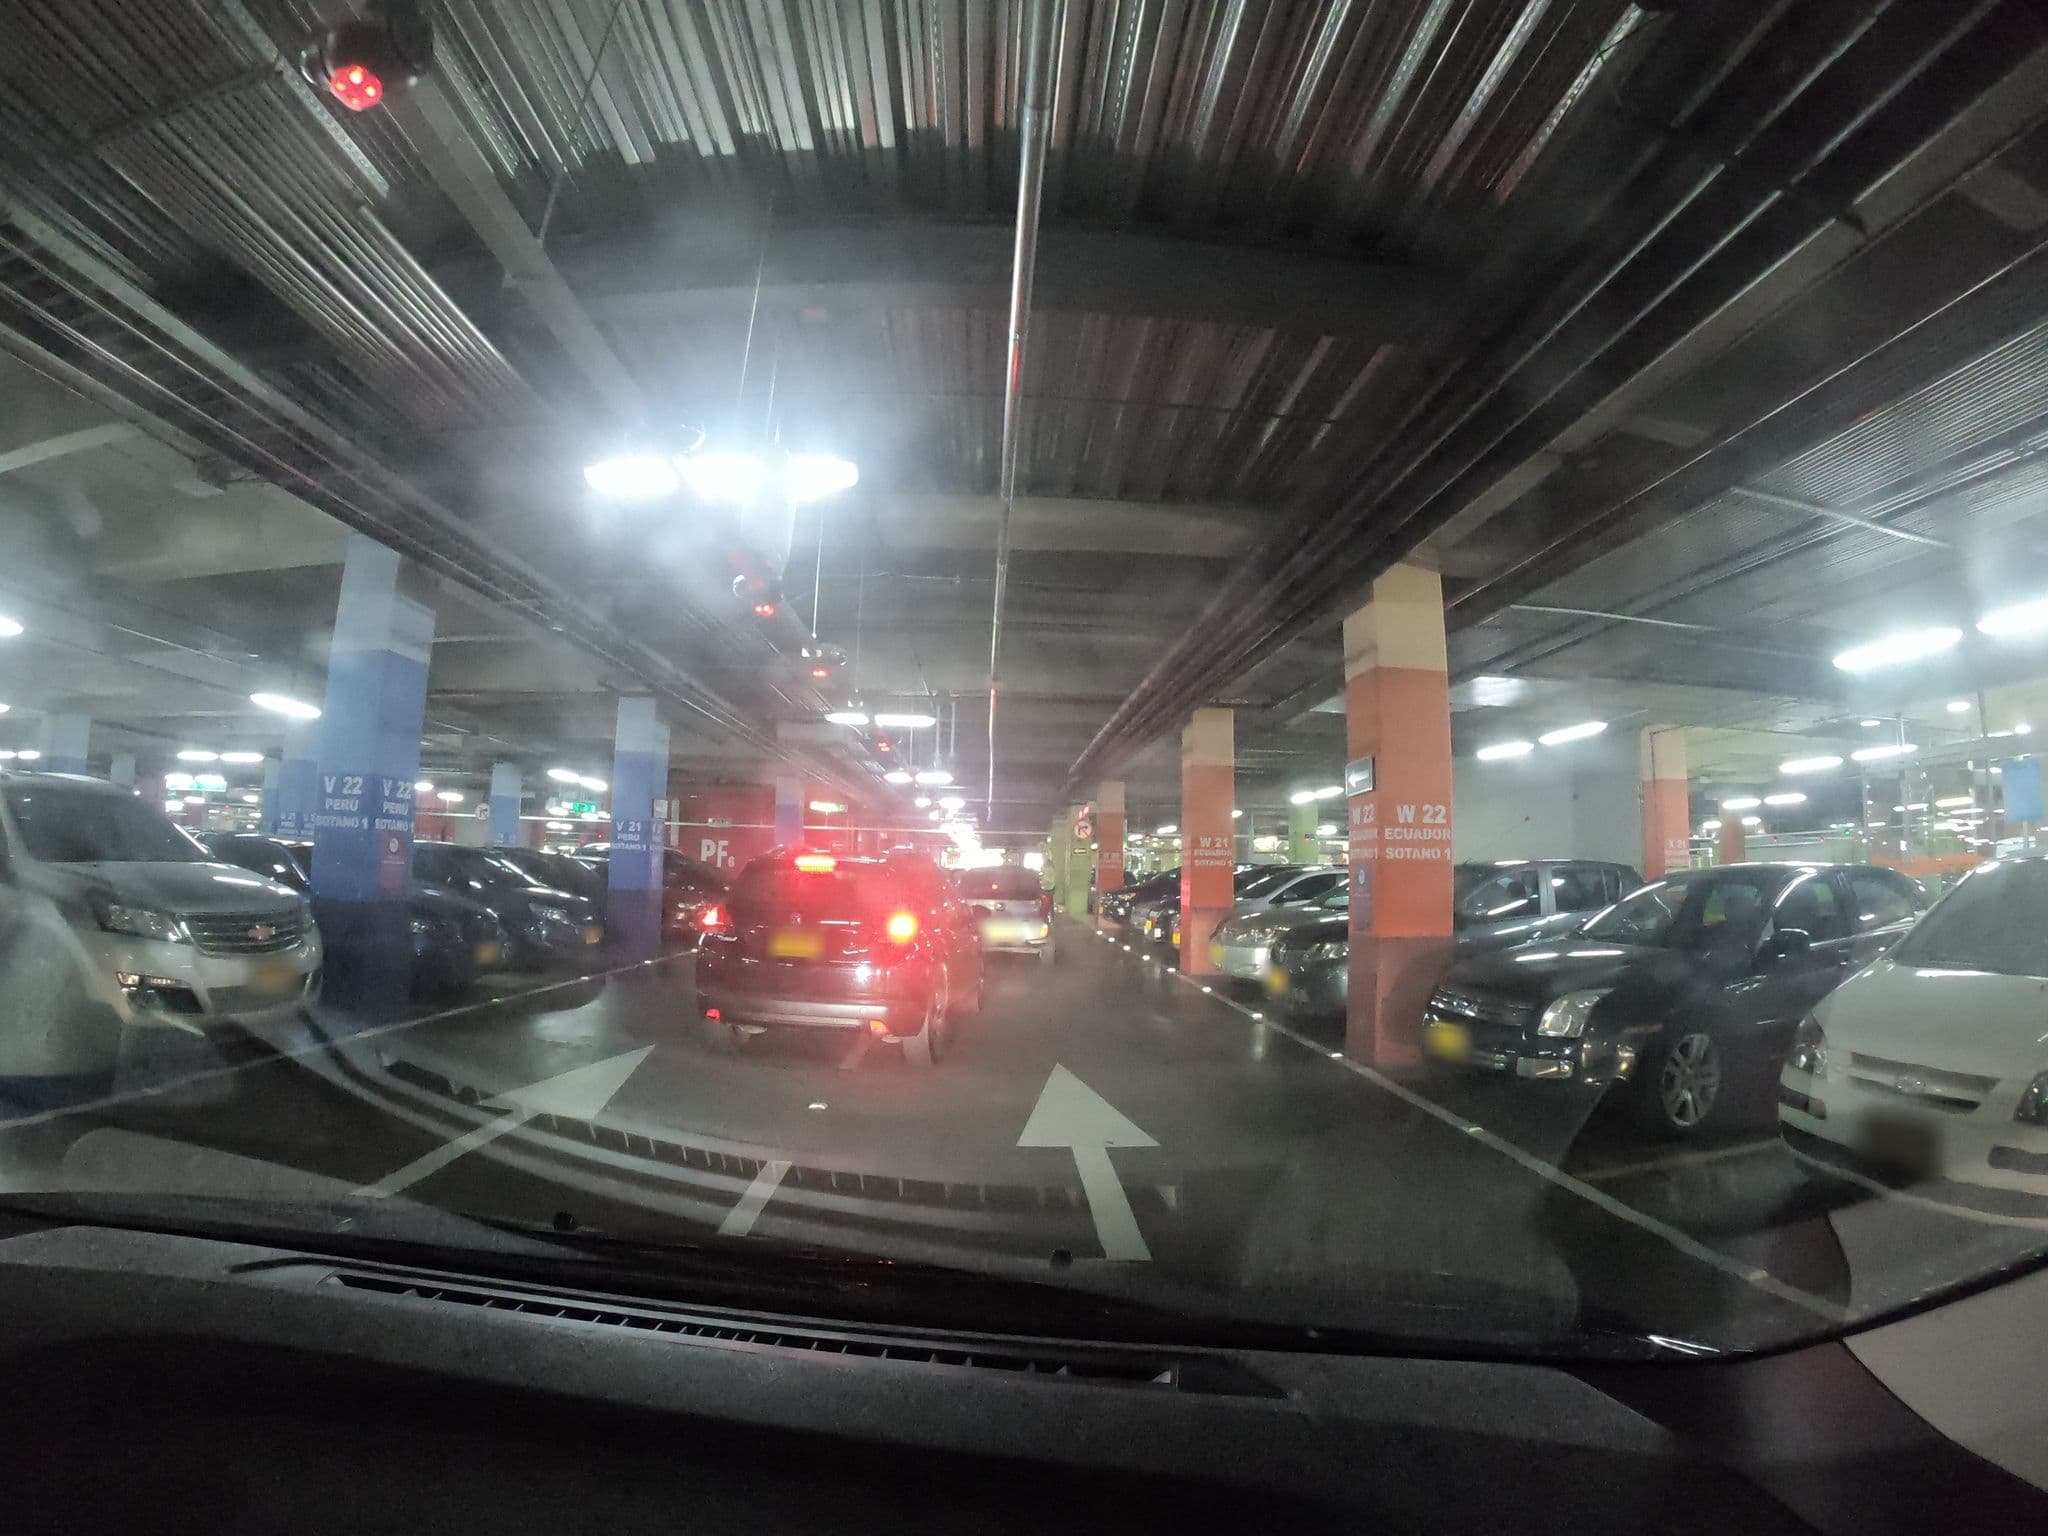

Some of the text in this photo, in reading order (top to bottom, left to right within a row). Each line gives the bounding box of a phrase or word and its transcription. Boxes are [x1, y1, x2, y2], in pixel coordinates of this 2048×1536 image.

[324, 775, 363, 795] V 22
[383, 779, 412, 800] V 22
[325, 798, 359, 812] PERU
[1352, 803, 1375, 825] W 22
[1397, 804, 1447, 824] W 22
[362, 817, 369, 830] 1
[616, 821, 641, 832] V 21
[1384, 827, 1452, 841] ECUADOR
[1200, 836, 1229, 848] W 21
[1385, 846, 1441, 860] SOTANO
[1443, 846, 1451, 860] 1
